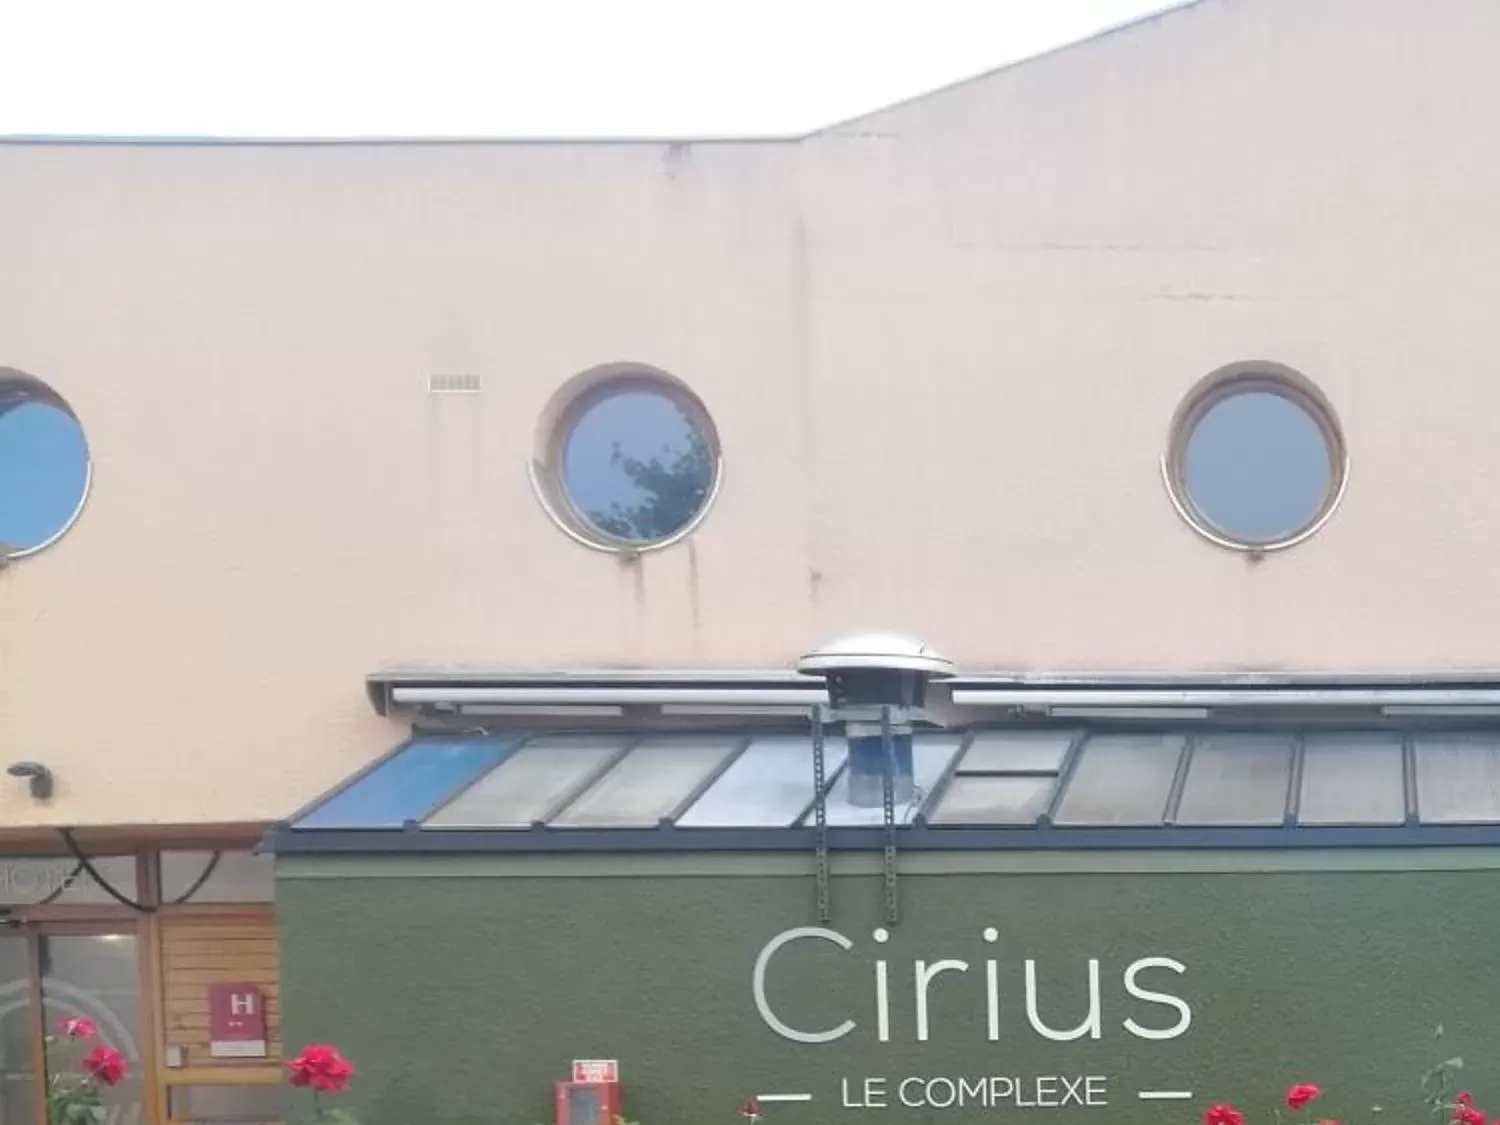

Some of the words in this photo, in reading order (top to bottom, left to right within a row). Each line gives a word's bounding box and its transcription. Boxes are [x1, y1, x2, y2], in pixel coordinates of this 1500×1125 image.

[752, 926, 1192, 1042] Cirius
[231, 993, 254, 1015] H
[842, 1077, 888, 1107] LE
[899, 1075, 1109, 1107] COMPLEXE
